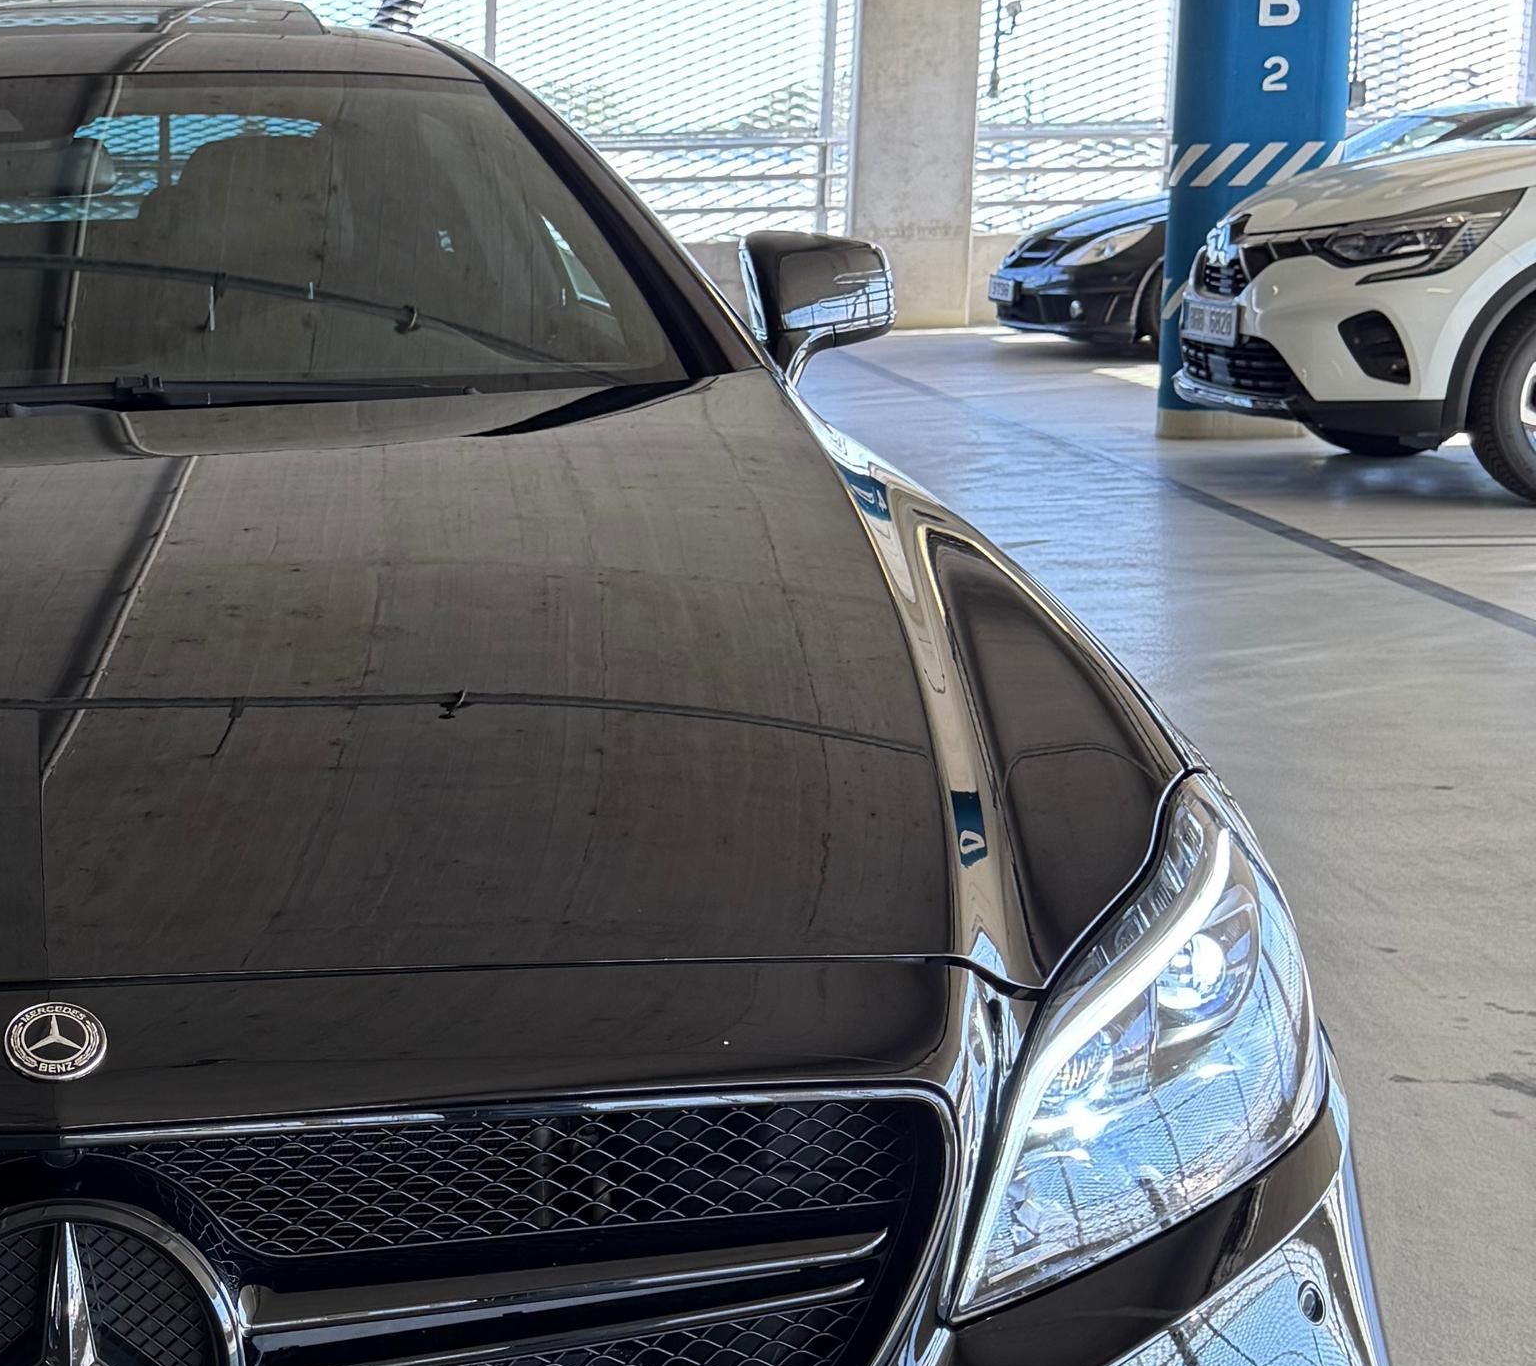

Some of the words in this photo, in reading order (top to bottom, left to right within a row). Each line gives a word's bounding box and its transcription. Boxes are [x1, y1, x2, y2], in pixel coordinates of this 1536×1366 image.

[1261, 56, 1289, 92] 2
[20, 1005, 87, 1023] MERCEDES
[38, 1062, 76, 1074] BENZ
